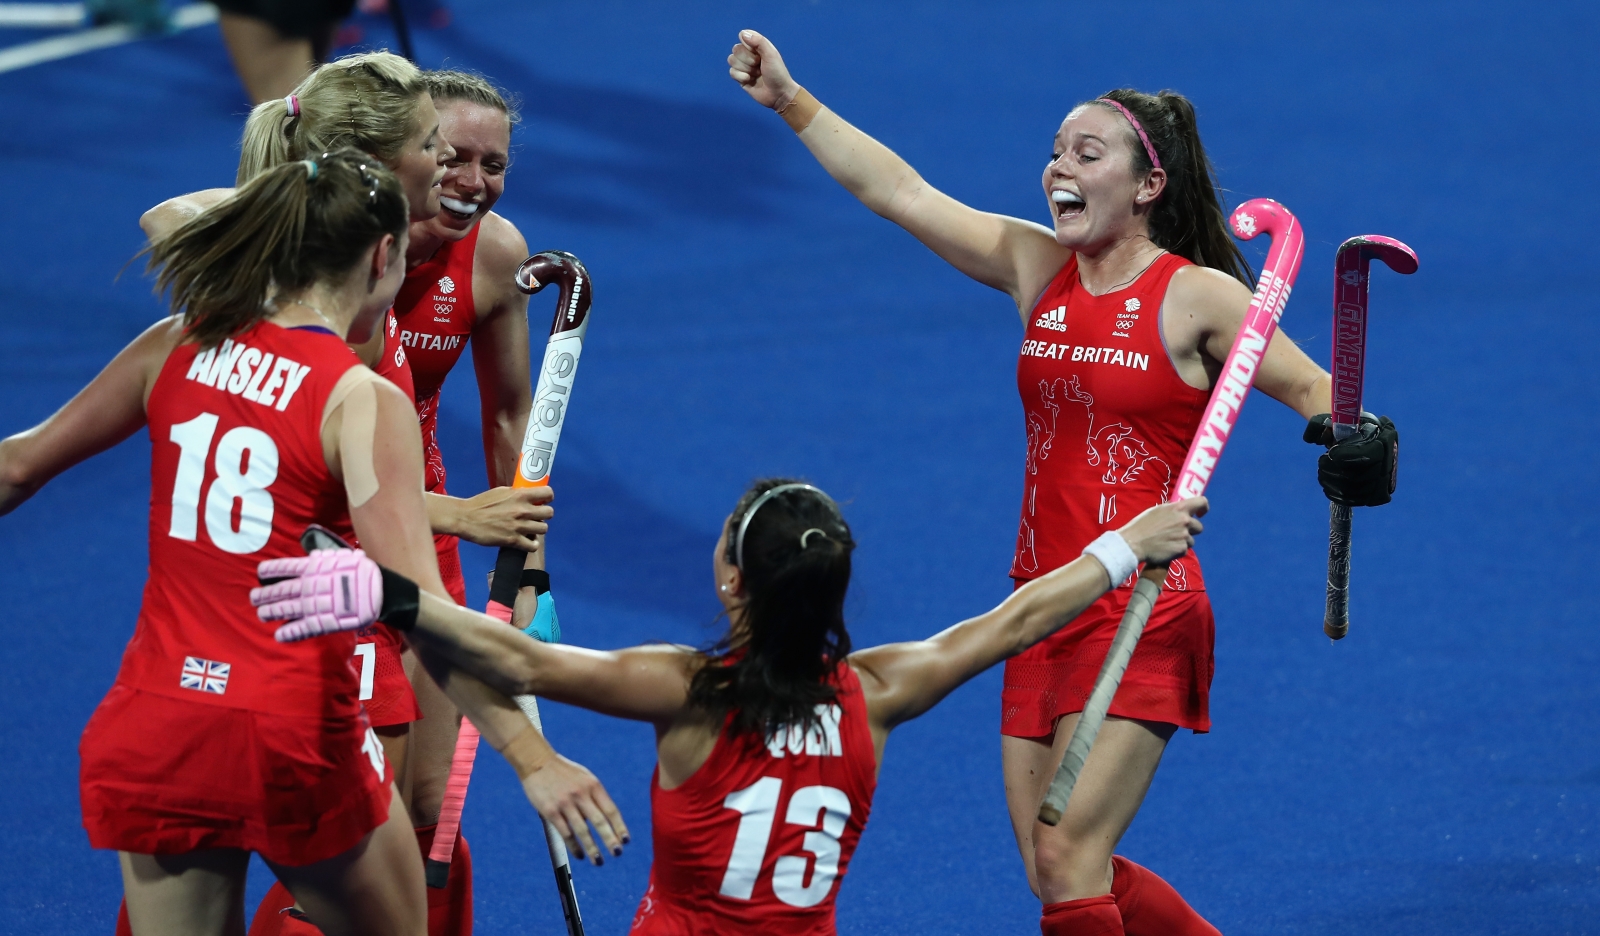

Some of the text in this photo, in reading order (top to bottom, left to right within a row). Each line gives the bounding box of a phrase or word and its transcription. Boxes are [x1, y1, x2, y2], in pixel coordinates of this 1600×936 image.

[567, 276, 583, 323] JUMBOW
[1262, 276, 1284, 314] TOUR
[400, 330, 460, 351] RITAIN
[1021, 339, 1150, 371] GREAT BRITAIN
[1036, 318, 1067, 333] adidas
[186, 338, 311, 412] ANSLEY
[1333, 301, 1363, 418] GRYPHON
[1178, 324, 1267, 500] GRYPHON
[168, 412, 279, 554] 18
[719, 776, 852, 908] 13
